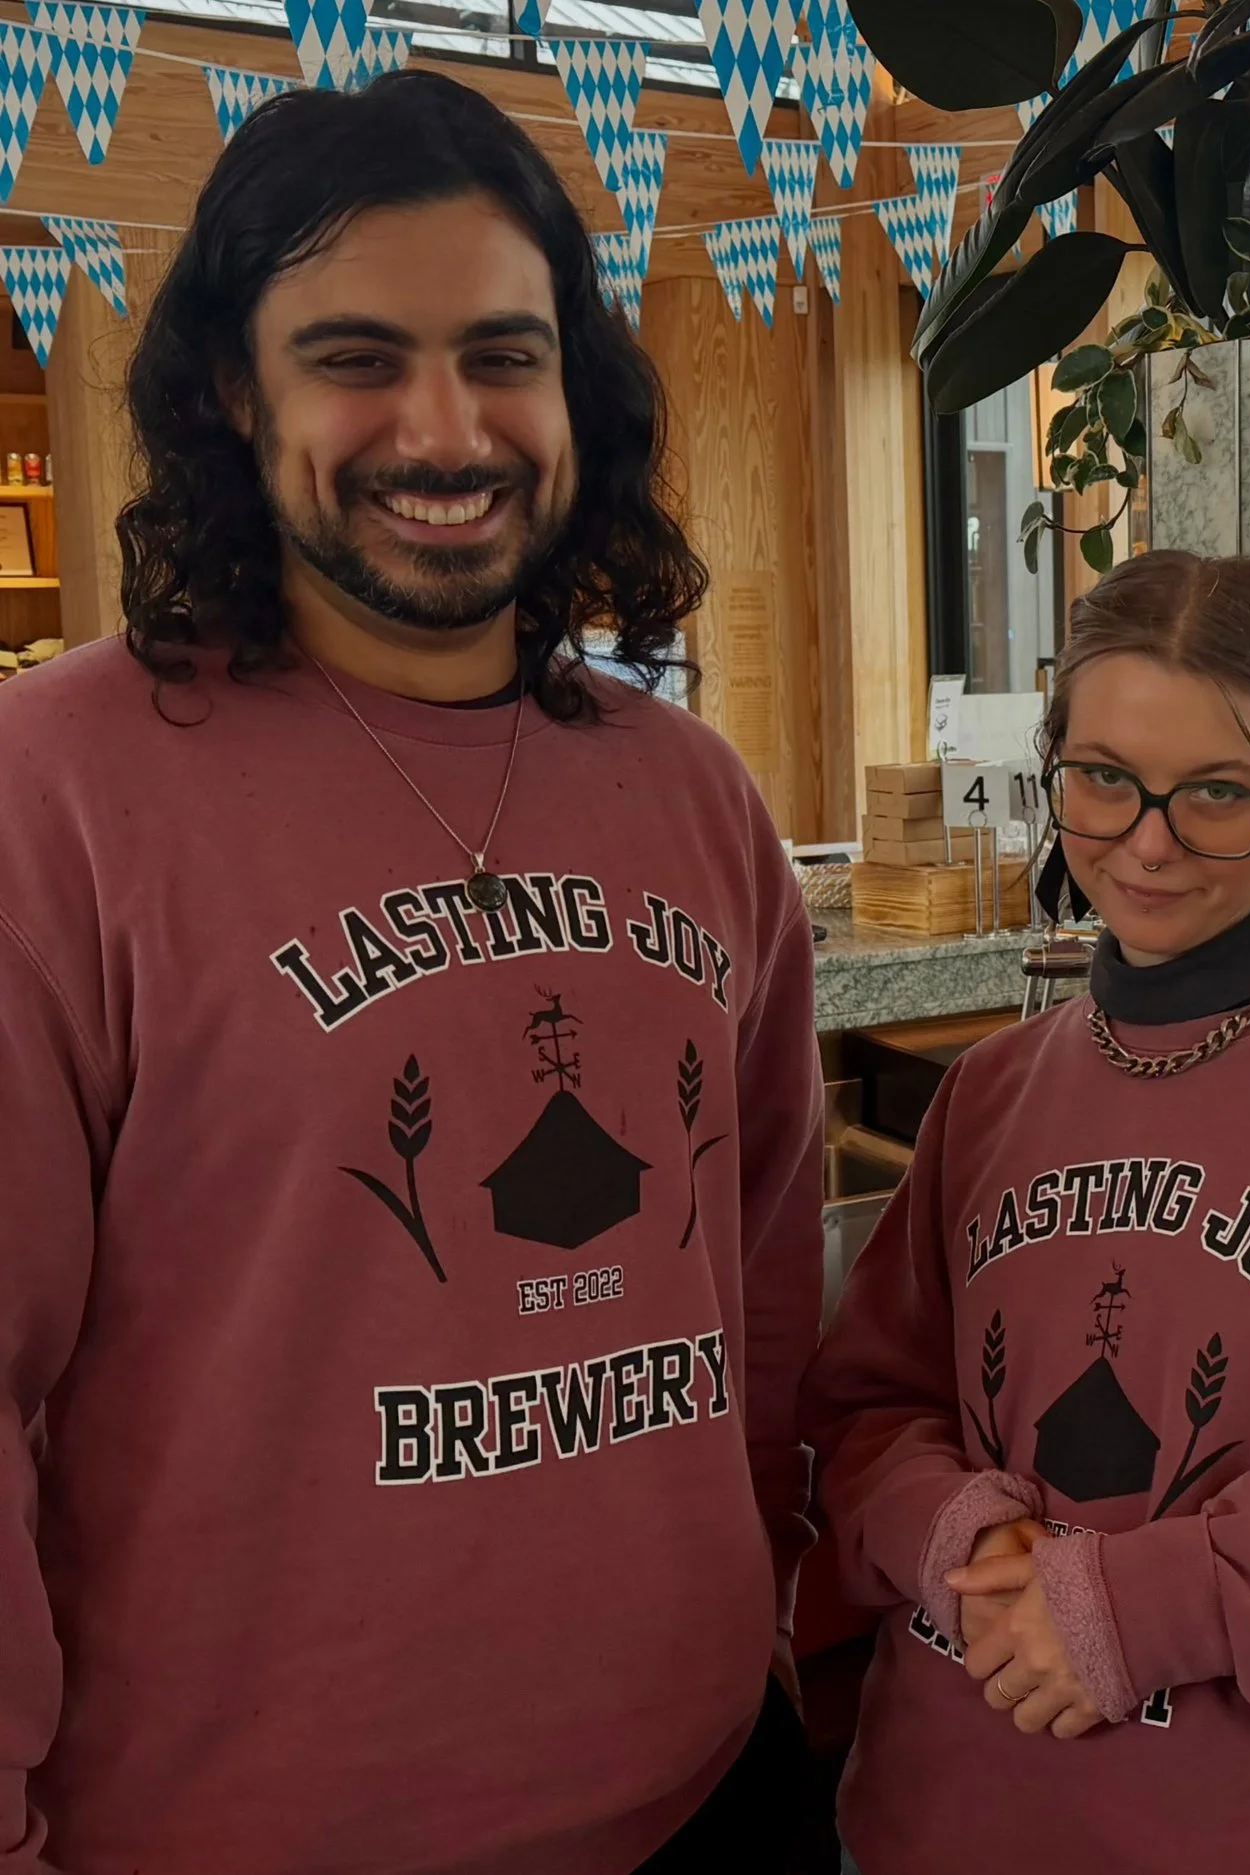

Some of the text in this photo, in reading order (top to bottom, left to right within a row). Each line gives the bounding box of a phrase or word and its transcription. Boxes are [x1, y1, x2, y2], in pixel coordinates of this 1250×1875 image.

[963, 776, 989, 811] 4
[1014, 772, 1038, 808] 11
[270, 873, 732, 1033] LASTING JOY
[965, 1157, 1205, 1288] LASTING
[518, 1267, 624, 1315] EST 2022
[374, 1328, 729, 1486] BREWERY
